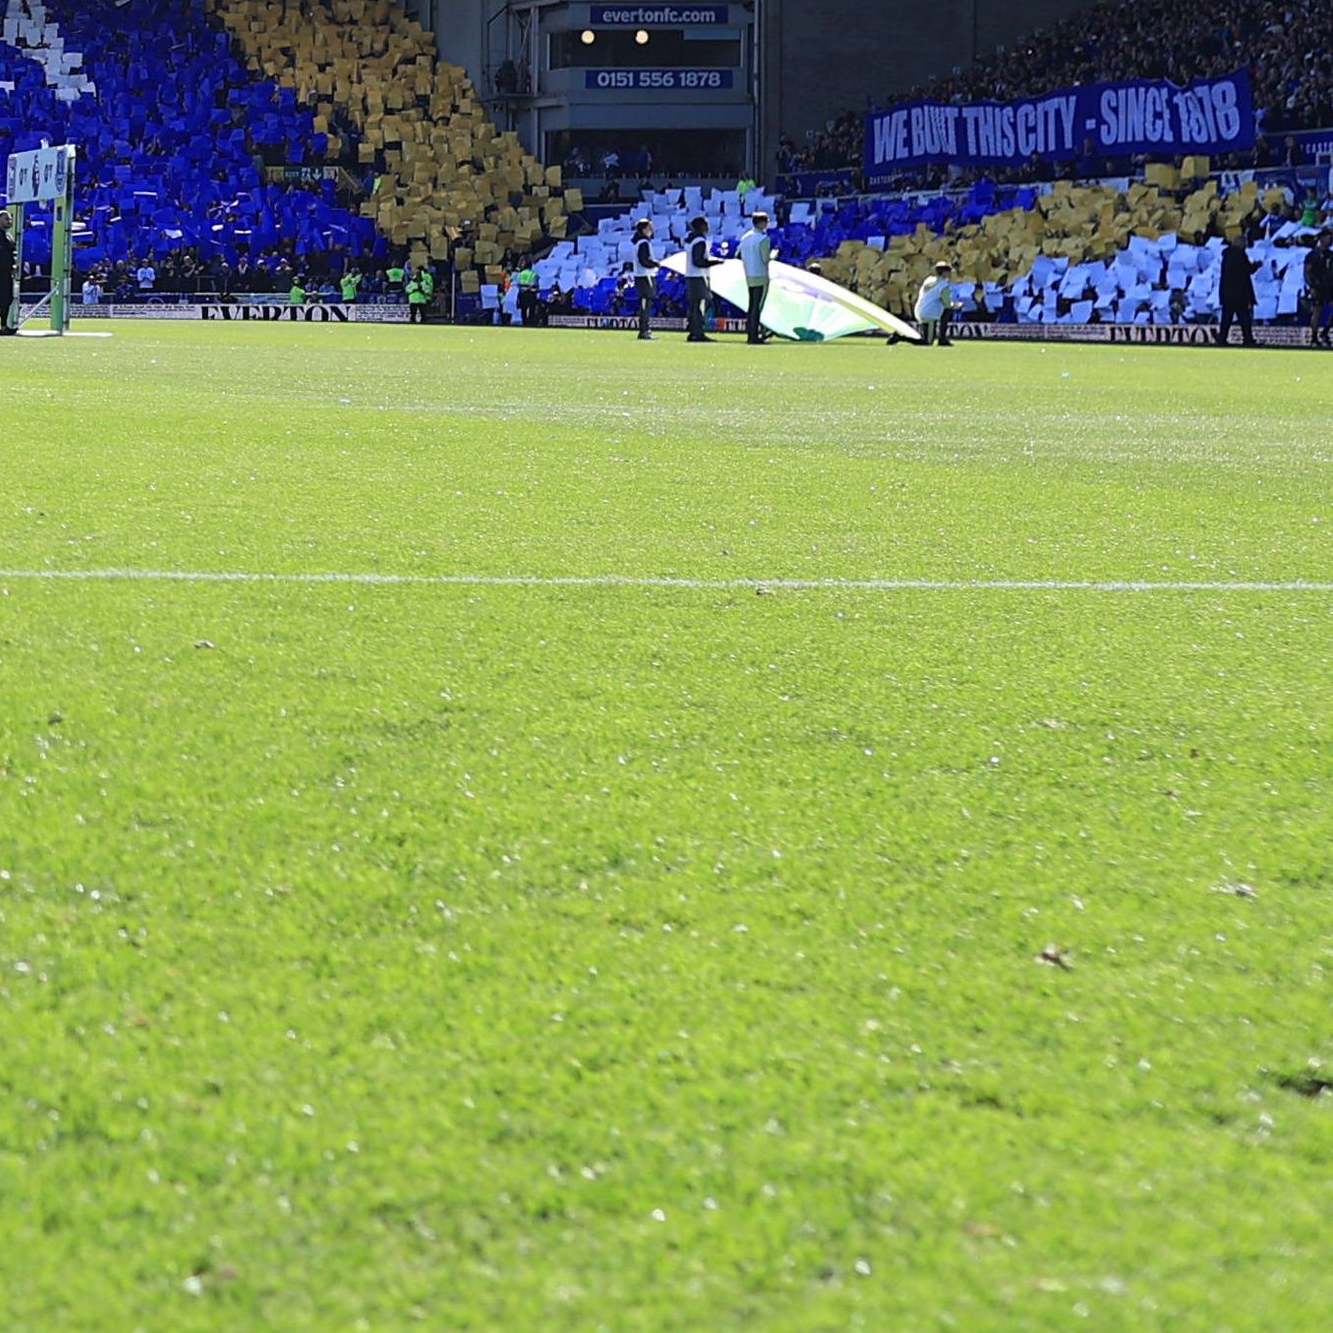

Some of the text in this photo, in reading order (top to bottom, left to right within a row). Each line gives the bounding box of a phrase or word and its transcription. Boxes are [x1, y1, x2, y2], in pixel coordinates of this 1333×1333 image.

[602, 7, 716, 23] evertonfc.com
[597, 72, 721, 87] 0151 556 1878
[874, 110, 908, 164] WE
[962, 106, 1015, 157] THIS
[1017, 95, 1077, 157] CITY
[1101, 87, 1174, 145] SINCE
[1173, 81, 1240, 144] 1878
[200, 305, 351, 322] EVERTON
